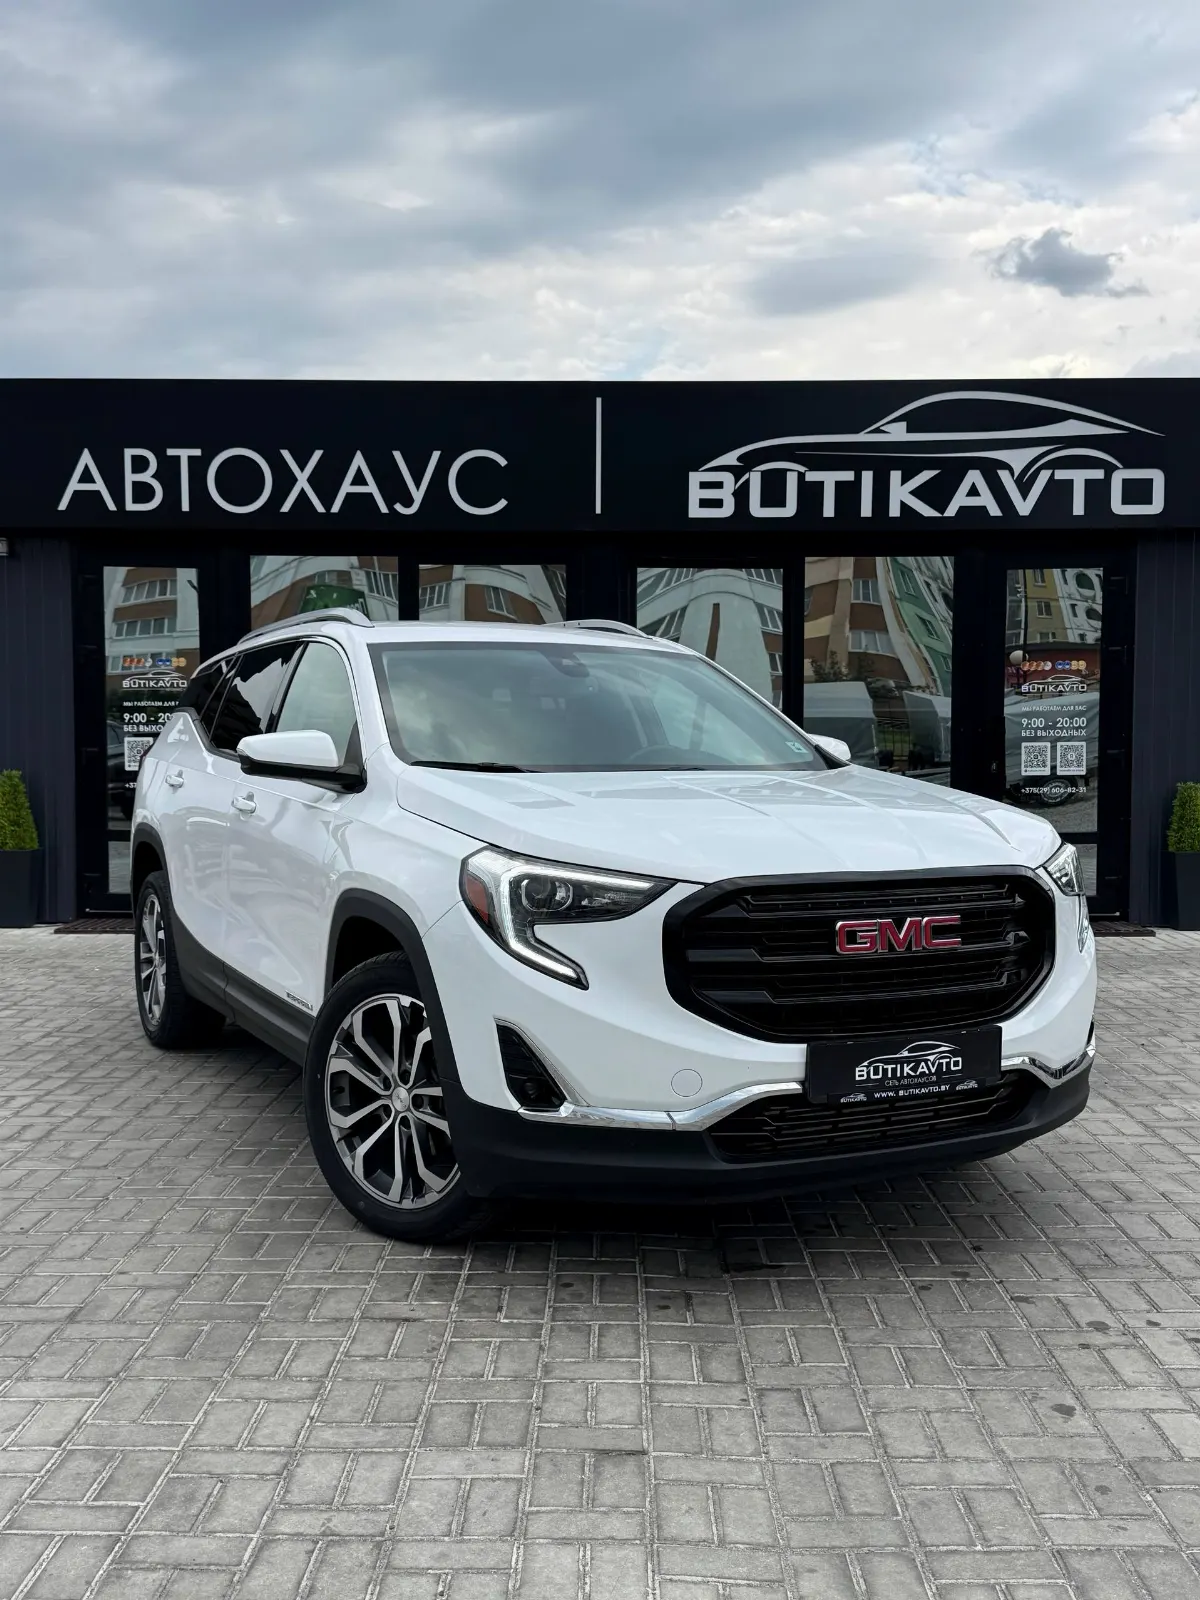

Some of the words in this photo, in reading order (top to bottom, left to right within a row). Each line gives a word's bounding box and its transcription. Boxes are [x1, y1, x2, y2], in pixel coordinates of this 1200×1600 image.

[57, 447, 508, 515] АВТОХАУС
[688, 468, 1165, 518] BUTIKAVTO
[122, 680, 188, 688] BUTIKAVTO
[1021, 684, 1087, 693] BUTIKAVTO
[123, 713, 147, 723] 9:00
[1021, 718, 1045, 728] 9:00
[1056, 717, 1087, 728] 20:00
[1021, 729, 1035, 737] БЕЗ
[1037, 729, 1086, 737] ВЫХОДНЫХ
[836, 915, 961, 954] GMC
[855, 1057, 962, 1081] BUTIKAVTO
[874, 1091, 896, 1099] WWW.
[899, 1085, 951, 1096] BUTIKAVTO.BY
